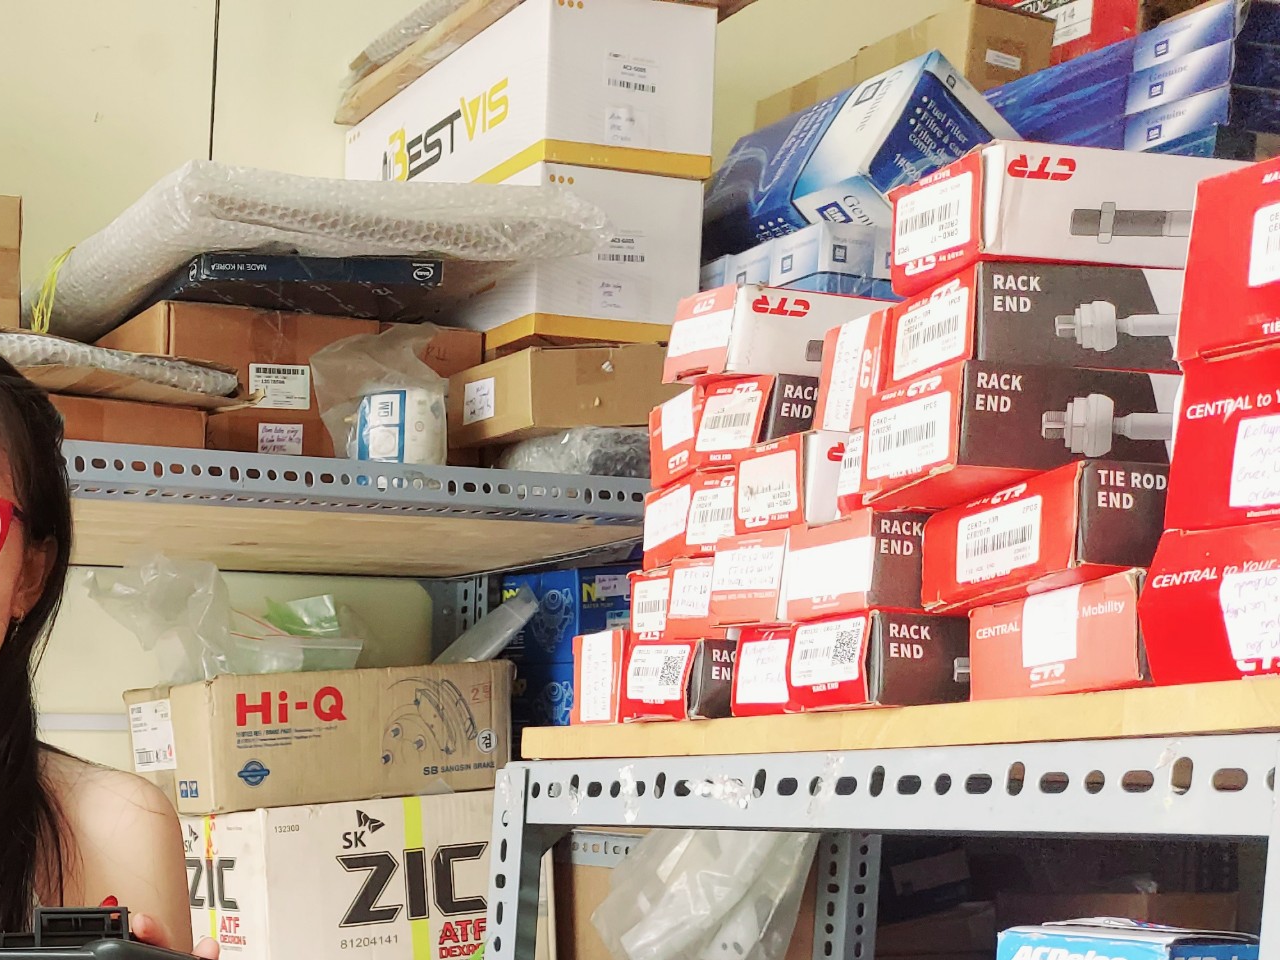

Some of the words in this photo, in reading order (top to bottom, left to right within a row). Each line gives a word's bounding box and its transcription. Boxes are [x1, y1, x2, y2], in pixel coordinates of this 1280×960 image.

[919, 111, 945, 139] Filtre
[926, 97, 947, 121] Fuel
[942, 116, 969, 145] Filter
[913, 121, 937, 151] Filtro
[1007, 154, 1077, 181] CTR
[211, 263, 235, 271] KOREA
[237, 263, 245, 271] IN
[247, 263, 267, 271] MADE
[993, 273, 1042, 293] RACK
[752, 295, 811, 317] CTR
[993, 294, 1032, 313] END
[1261, 320, 1280, 336] TIE
[907, 375, 943, 397] CTR
[976, 372, 1023, 392] RACK
[378, 401, 394, 418] GM
[780, 402, 812, 419] END
[975, 393, 1012, 413] END
[1186, 392, 1252, 420] CENTRAL
[1255, 391, 1272, 408] to
[668, 450, 690, 471] CTR
[1097, 468, 1125, 487] TIE
[1130, 471, 1167, 490] ROD
[990, 482, 1028, 505] CTR
[1097, 491, 1134, 510] END
[879, 518, 923, 537] RACK
[879, 538, 914, 556] END
[1151, 569, 1219, 589] CENTRAL
[1242, 558, 1272, 575] Your
[1082, 600, 1125, 618] Mobility
[888, 623, 932, 643] RACK
[975, 621, 1020, 640] CENTRAL
[888, 642, 925, 660] END
[1029, 663, 1066, 682] CTR
[235, 685, 348, 728] Hi-Q
[422, 764, 439, 776] SB
[440, 763, 471, 775] SANGSIN
[472, 760, 496, 773] BRAKE
[273, 824, 301, 834] 132300
[342, 830, 367, 850] SK
[185, 857, 240, 912] ZIC
[336, 840, 490, 928] ZIC
[219, 915, 241, 934] ATF
[438, 918, 488, 945] ATF
[339, 934, 399, 950] 81204141
